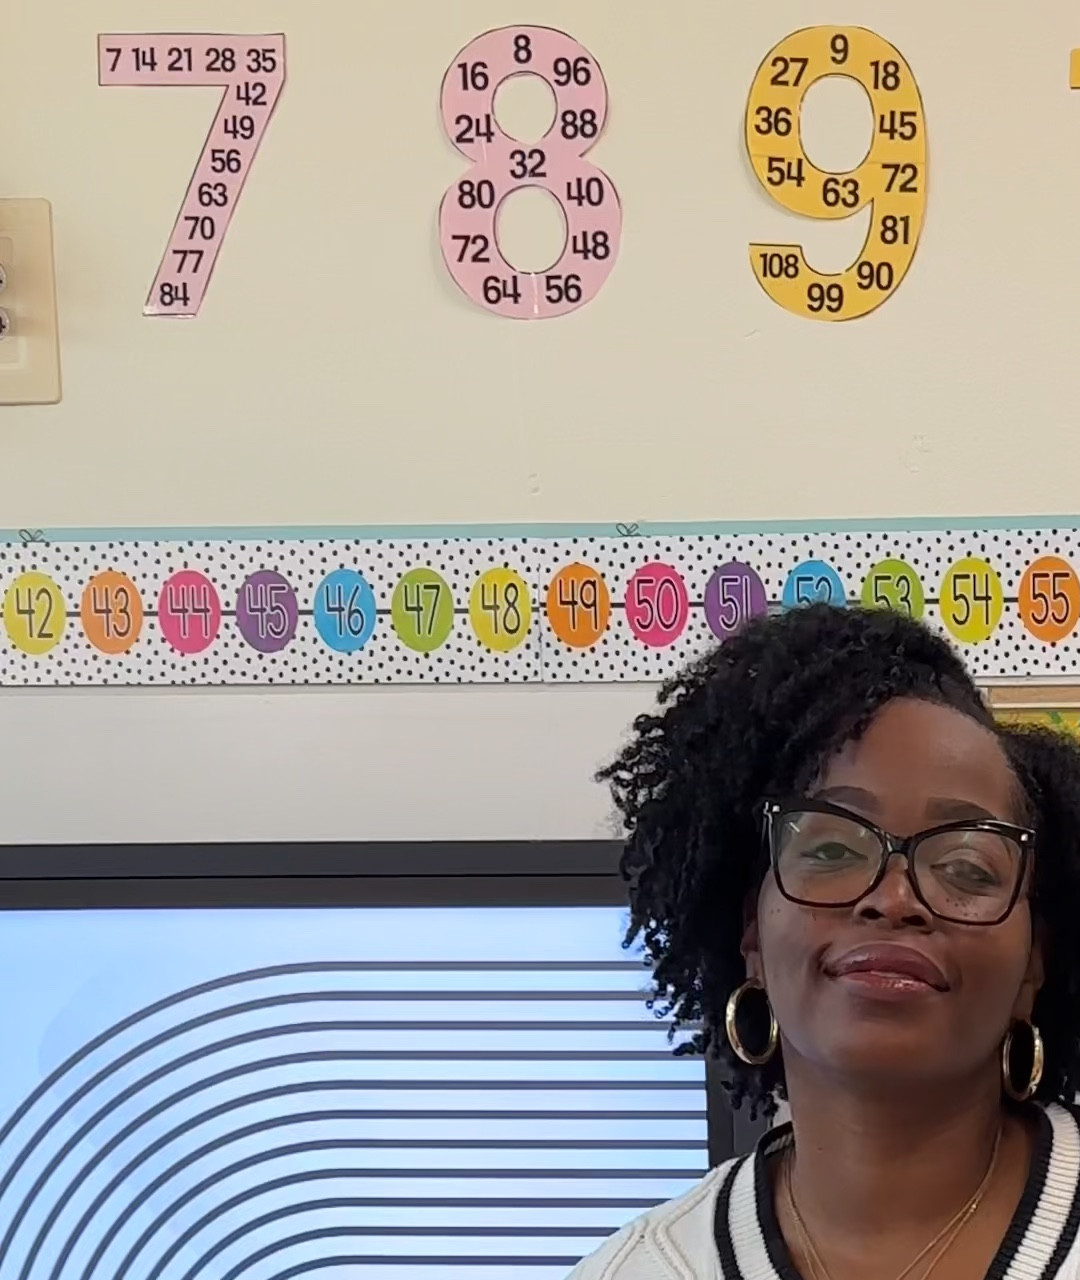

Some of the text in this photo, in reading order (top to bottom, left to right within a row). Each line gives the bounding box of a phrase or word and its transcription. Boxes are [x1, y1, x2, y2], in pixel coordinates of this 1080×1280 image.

[130, 48, 158, 72] 14
[246, 48, 277, 72] 35
[770, 57, 809, 86] 27
[456, 62, 490, 91] 16
[560, 111, 598, 139] 88
[878, 111, 917, 141] 45
[197, 183, 229, 206] 63
[571, 232, 611, 260] 48
[806, 283, 844, 313] 99
[15, 587, 54, 640] 42
[245, 585, 289, 639] 45
[480, 582, 521, 635] 48
[635, 578, 679, 631] 50
[952, 573, 992, 626] 54
